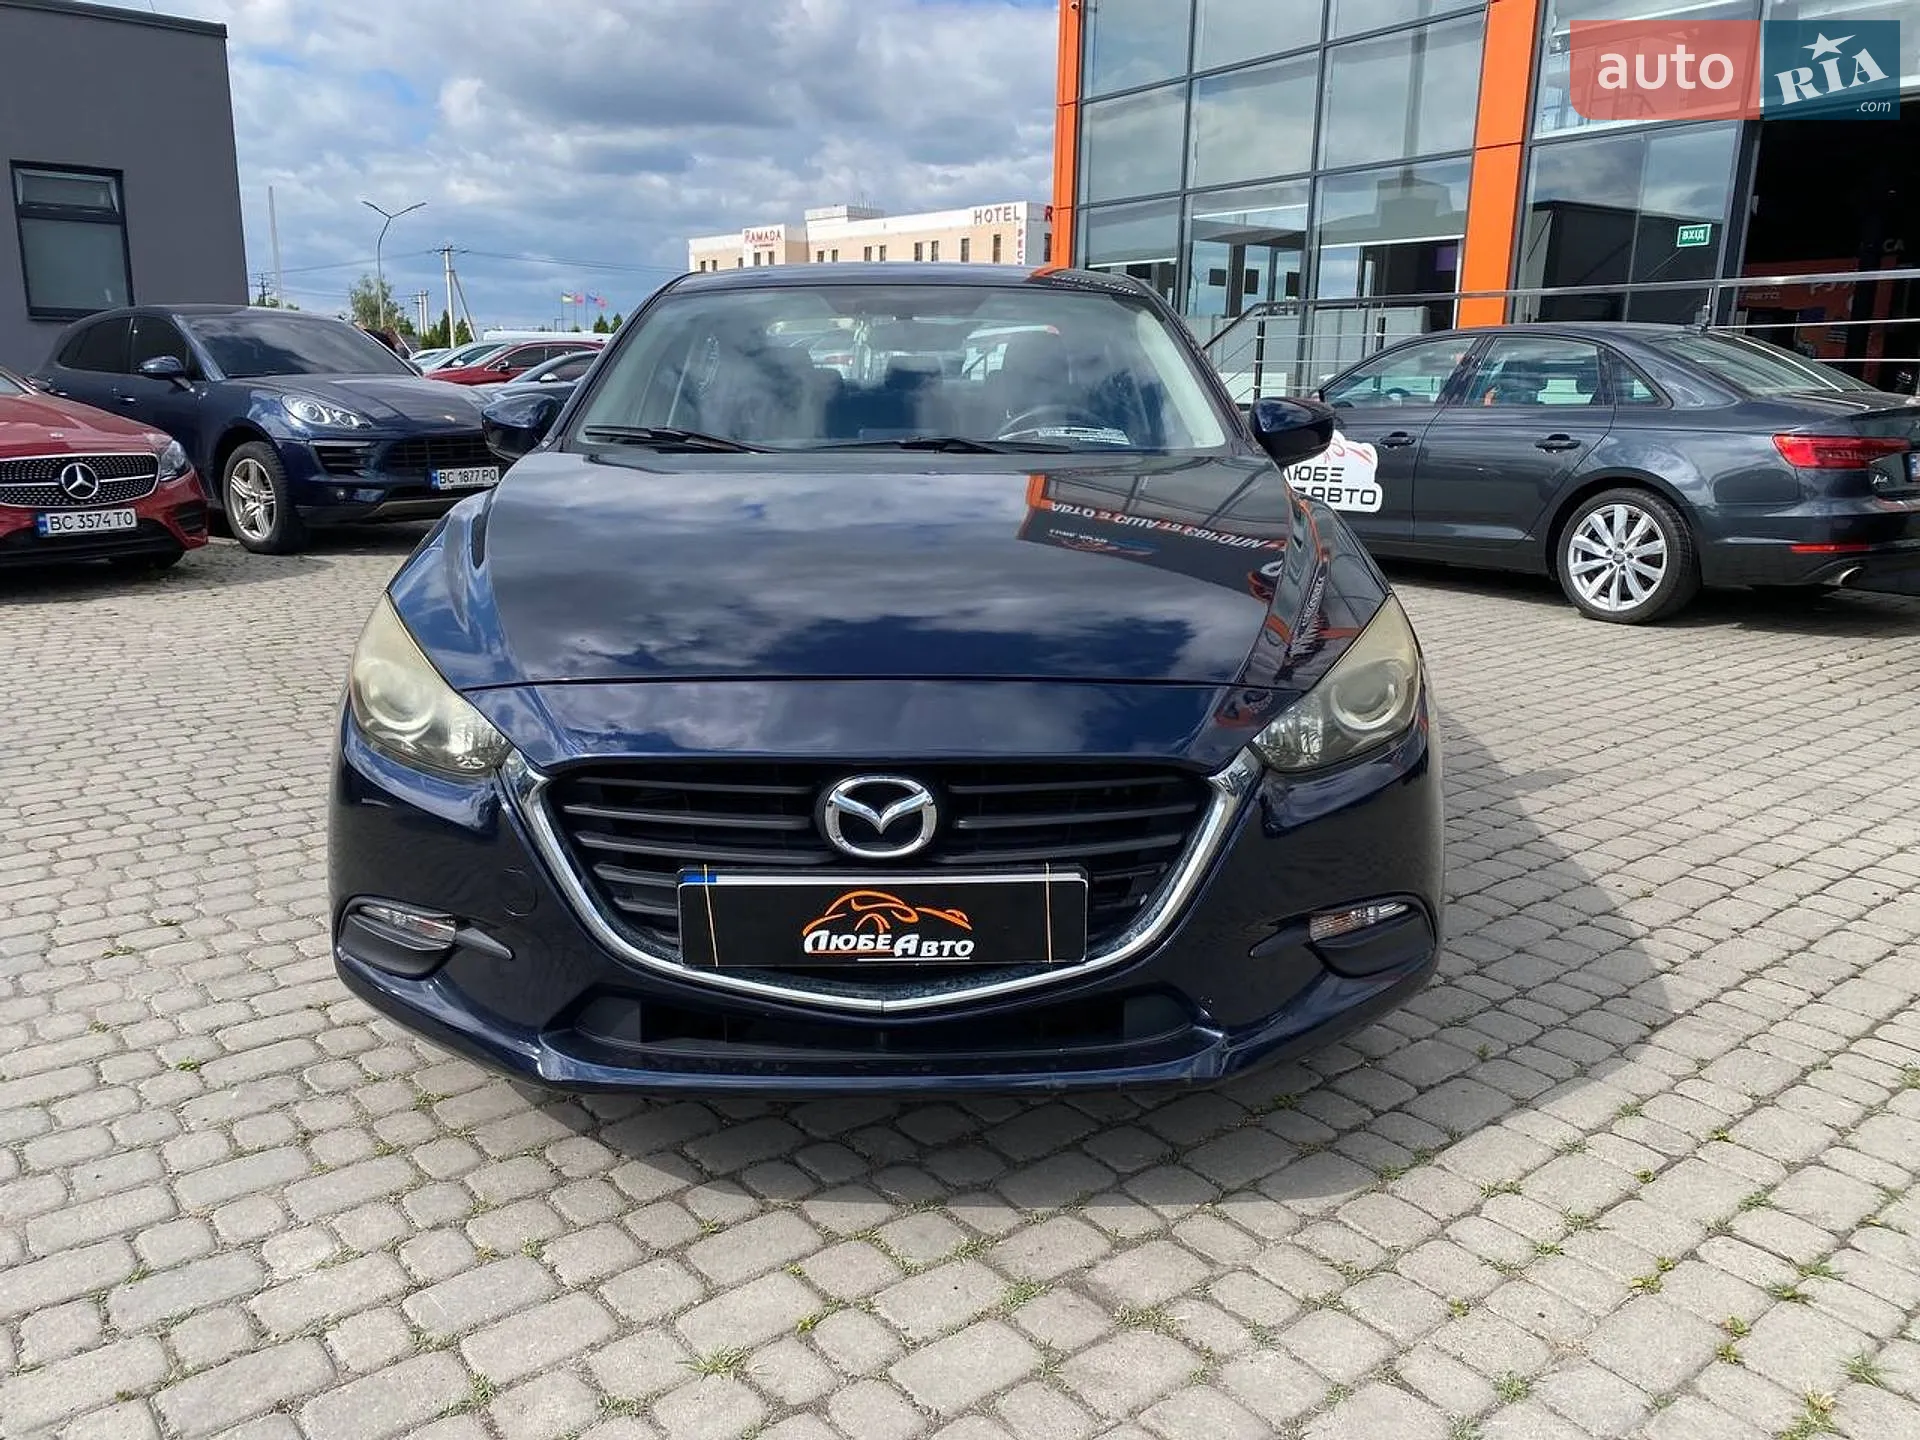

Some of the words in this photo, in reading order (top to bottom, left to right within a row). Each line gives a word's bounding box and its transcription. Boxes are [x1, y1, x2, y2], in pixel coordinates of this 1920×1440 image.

[974, 205, 1020, 224] HOTEL
[744, 230, 783, 243] RAMADA
[440, 471, 454, 484] BC
[481, 468, 497, 481] PO
[50, 515, 73, 530] BC
[77, 513, 111, 529] 3574
[114, 511, 133, 525] TO
